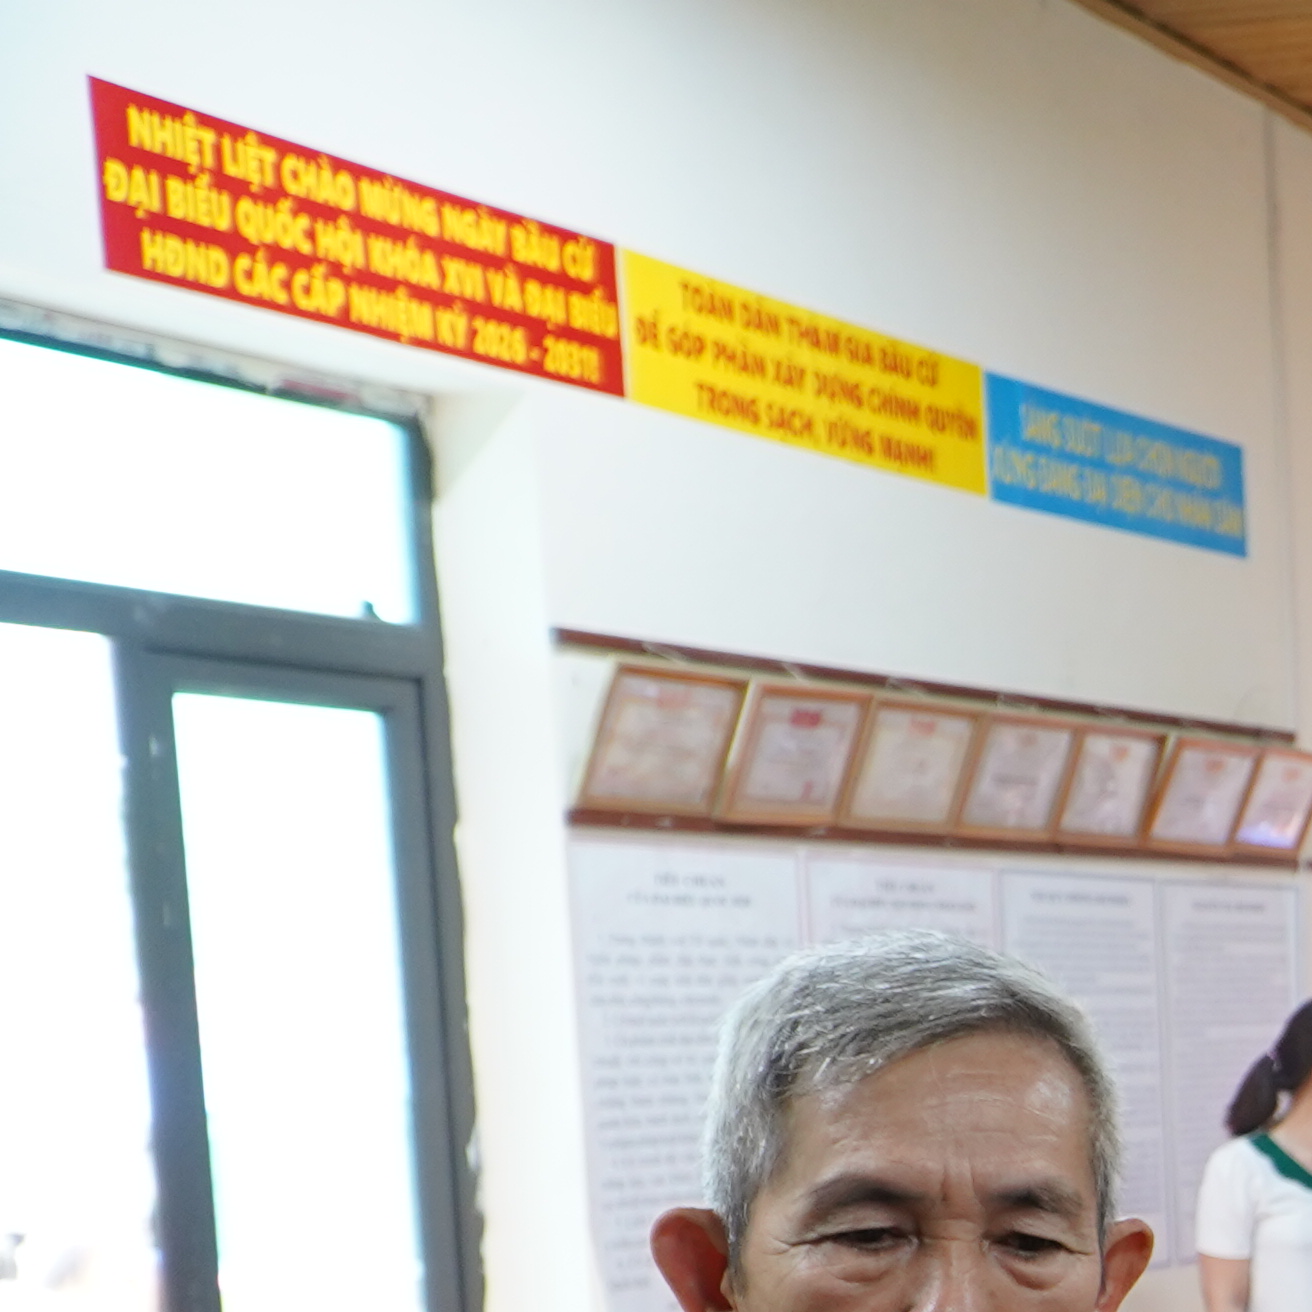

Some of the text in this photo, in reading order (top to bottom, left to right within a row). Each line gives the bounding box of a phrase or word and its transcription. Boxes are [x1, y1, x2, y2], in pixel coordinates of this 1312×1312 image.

[103, 156, 161, 218] ĐẠI
[166, 171, 232, 232] BIỂU
[234, 195, 312, 255] QUỐC
[314, 214, 365, 274] HỘI
[486, 263, 524, 311] VÀ
[523, 277, 566, 329] ĐẠI
[568, 286, 619, 339] BIỂU
[127, 103, 596, 283] NHIỆT LIỆT CHÀO MỪNG NGÀY BẦU CỬ
[140, 227, 230, 288] HĐND
[233, 246, 289, 306] CÁC
[290, 261, 346, 317] CẤP
[349, 282, 434, 343] NHIỆM
[435, 299, 468, 349] KỲ
